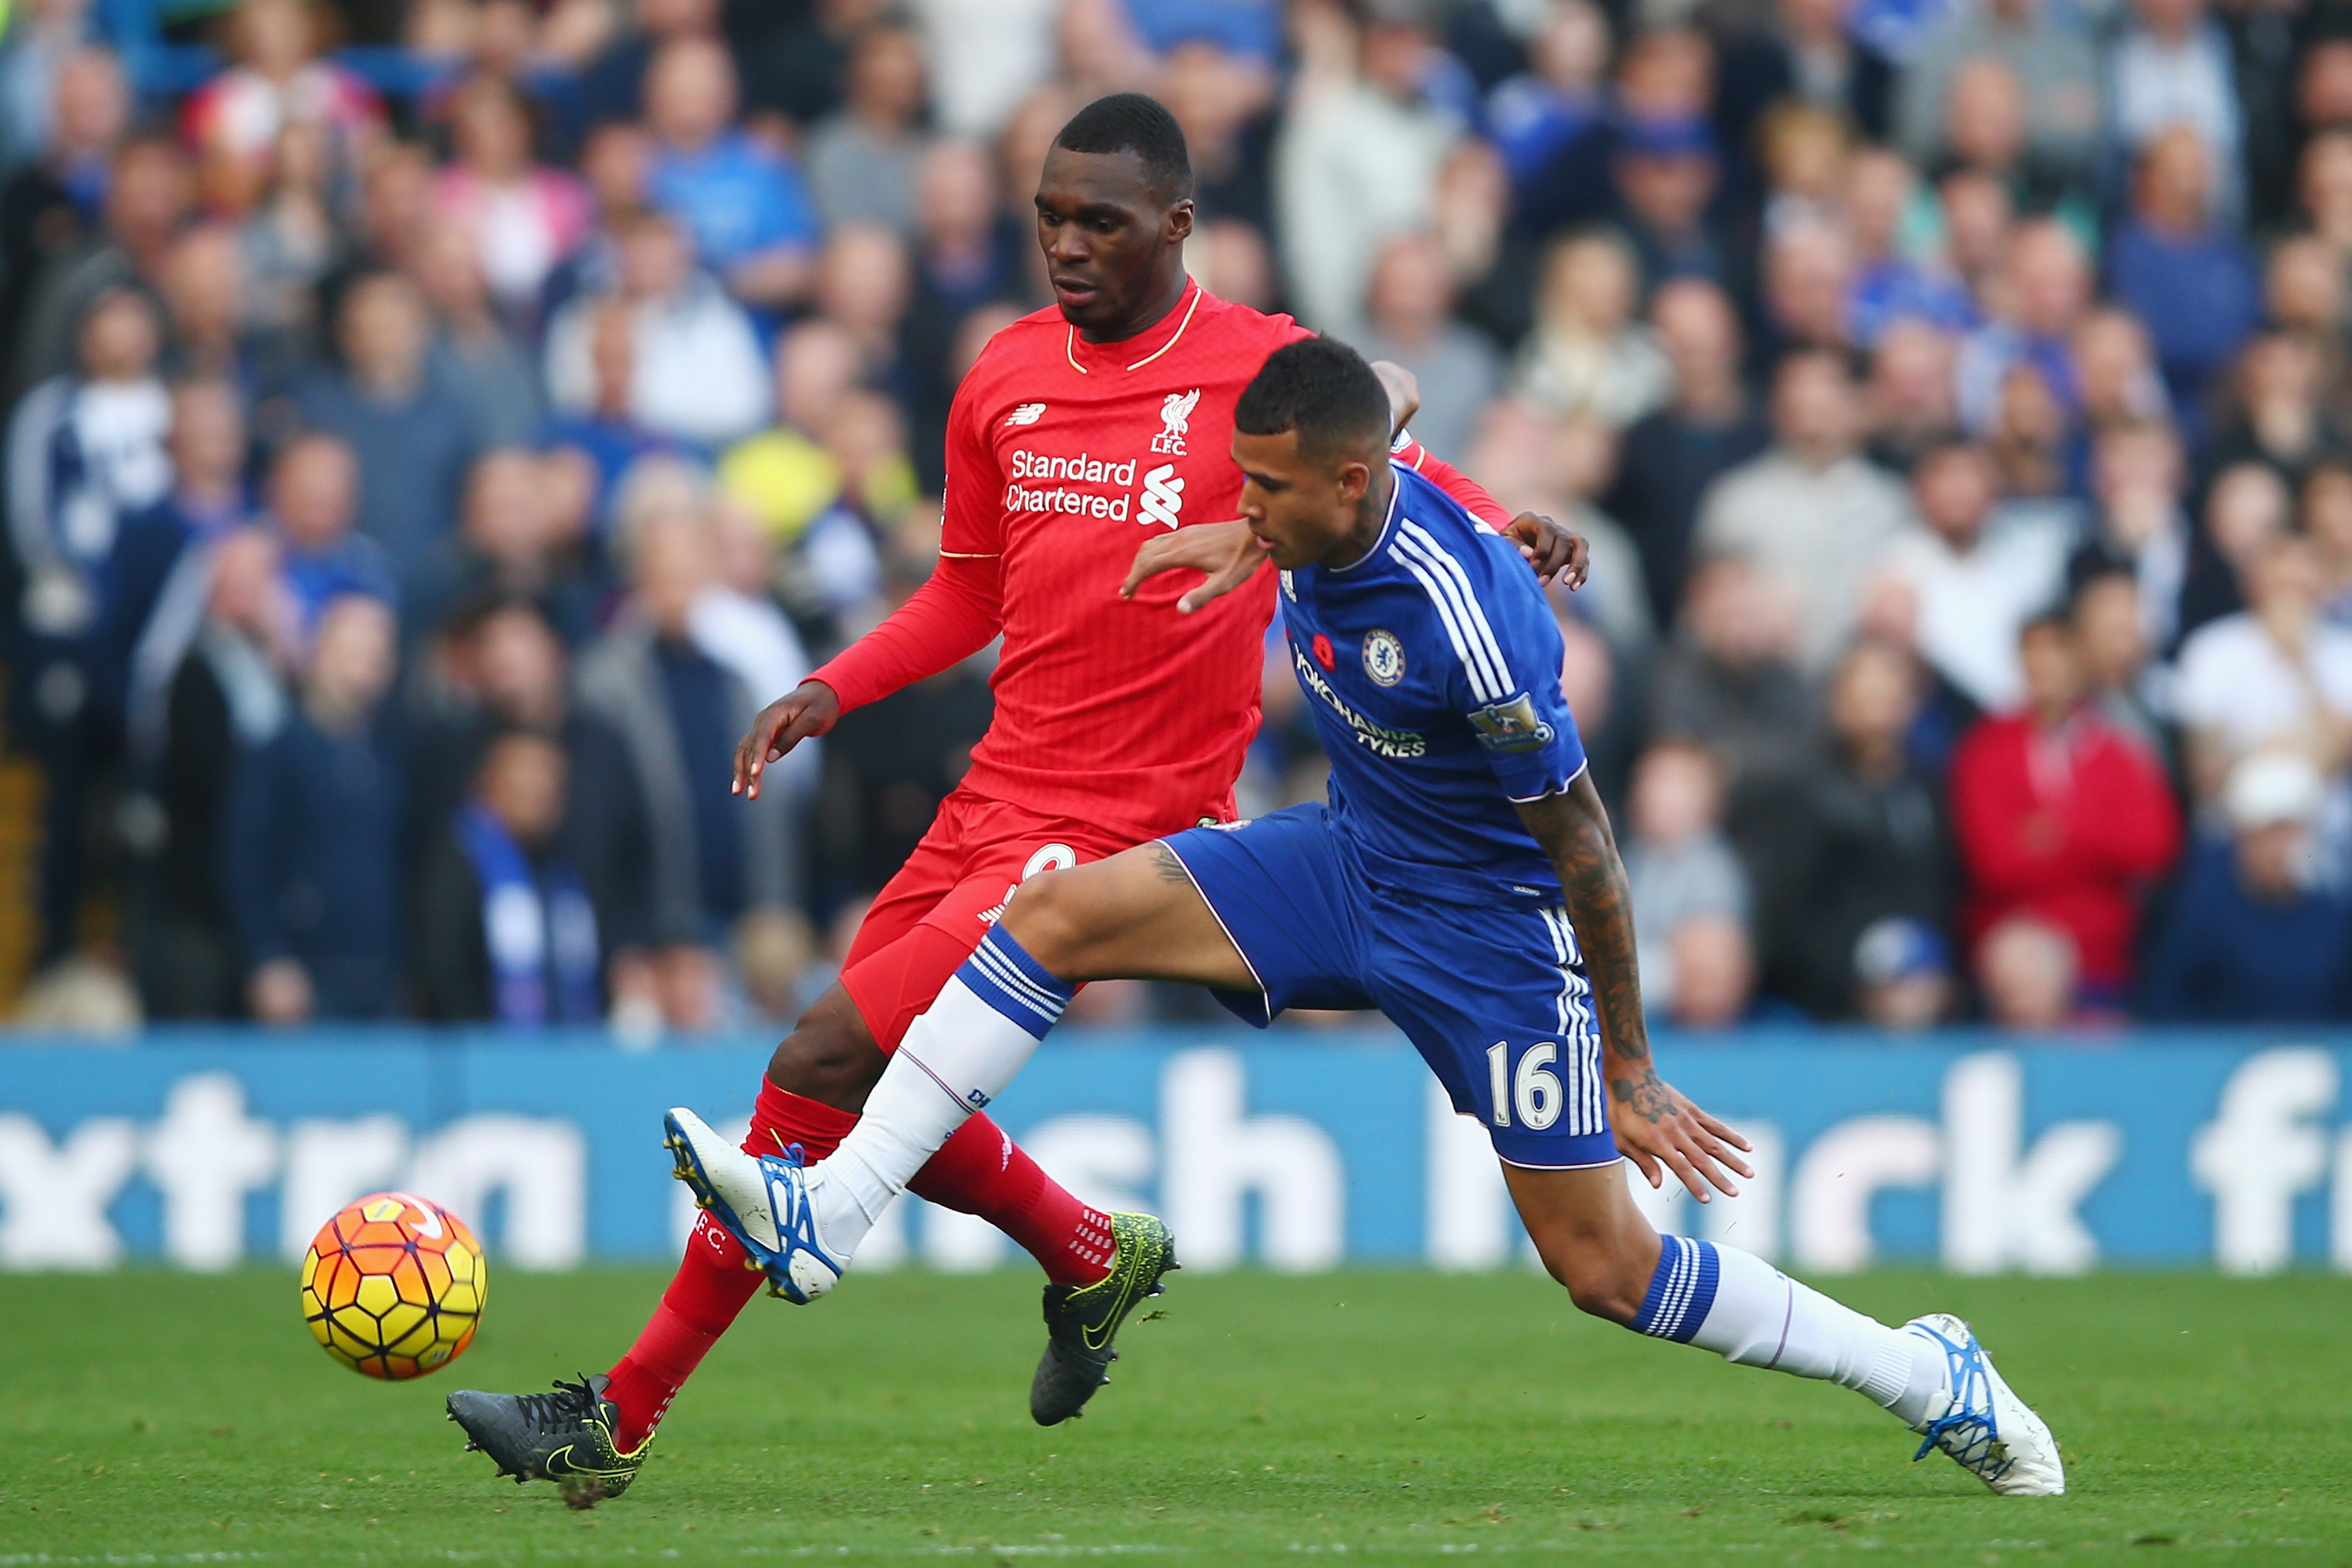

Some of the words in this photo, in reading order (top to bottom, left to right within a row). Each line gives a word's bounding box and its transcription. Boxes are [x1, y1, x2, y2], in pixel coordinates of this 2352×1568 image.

[1012, 449, 1137, 487] Standard
[1006, 484, 1130, 522] Chartered
[1357, 731, 1426, 757] TYRES
[1486, 1040, 1563, 1130] 16
